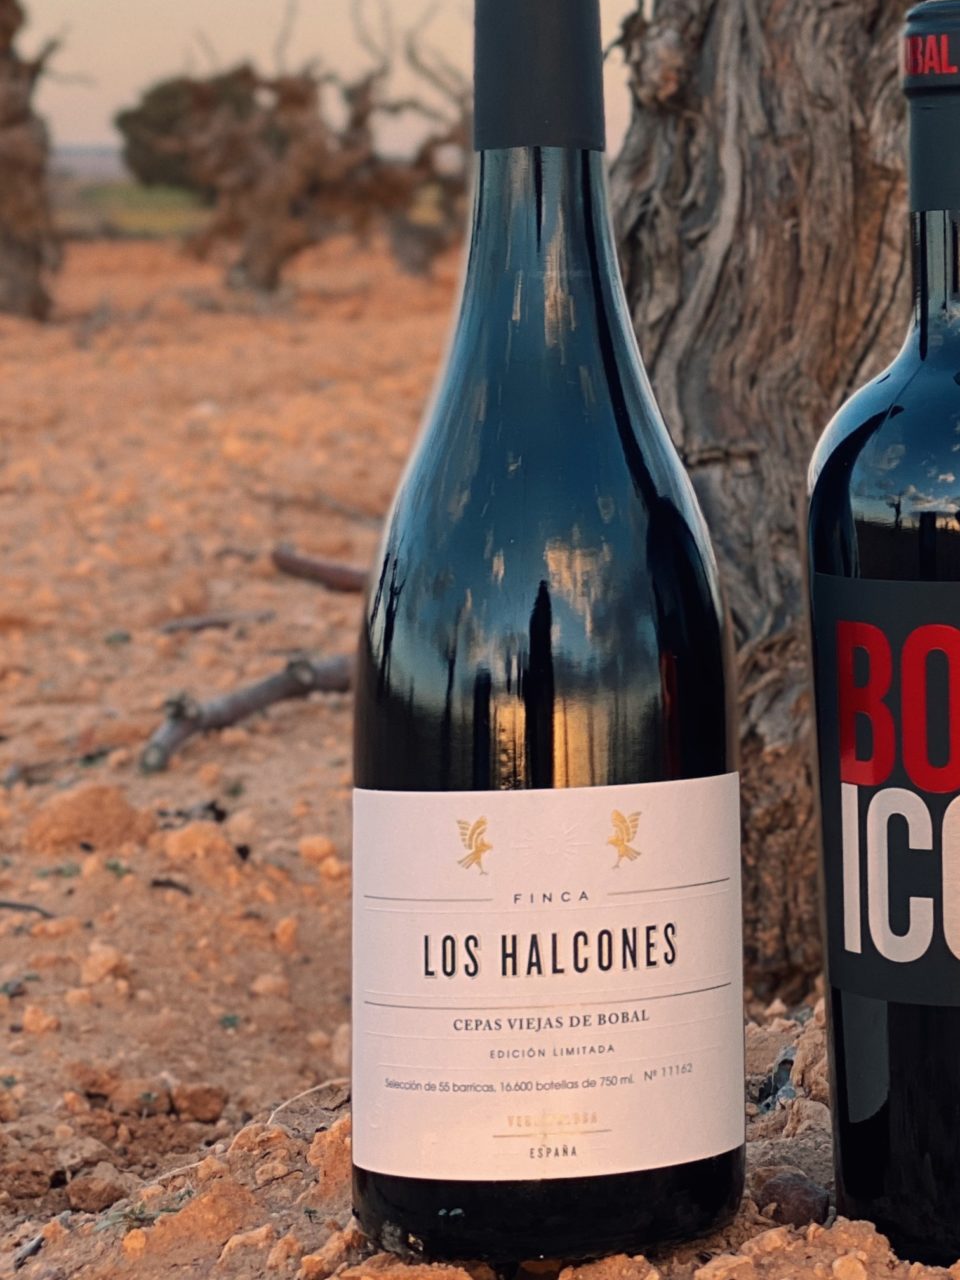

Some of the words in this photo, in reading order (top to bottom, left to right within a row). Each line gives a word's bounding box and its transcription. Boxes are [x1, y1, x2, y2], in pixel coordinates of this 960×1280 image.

[513, 891, 589, 904] FINCA
[424, 934, 479, 978] LOS
[501, 922, 677, 977] HALCONES
[453, 1018, 502, 1032] CEPAS
[508, 1016, 564, 1033] VIEJAS
[569, 1015, 592, 1028] DE
[597, 1009, 650, 1026] BOBAL
[489, 1047, 546, 1059] EDICIÓN
[553, 1044, 615, 1057] LIMITADA
[424, 1081, 436, 1092] de
[536, 1079, 579, 1092] botellas
[582, 1078, 597, 1089] de
[600, 1075, 618, 1087] 750
[530, 1144, 577, 1159] ESPAÑA
